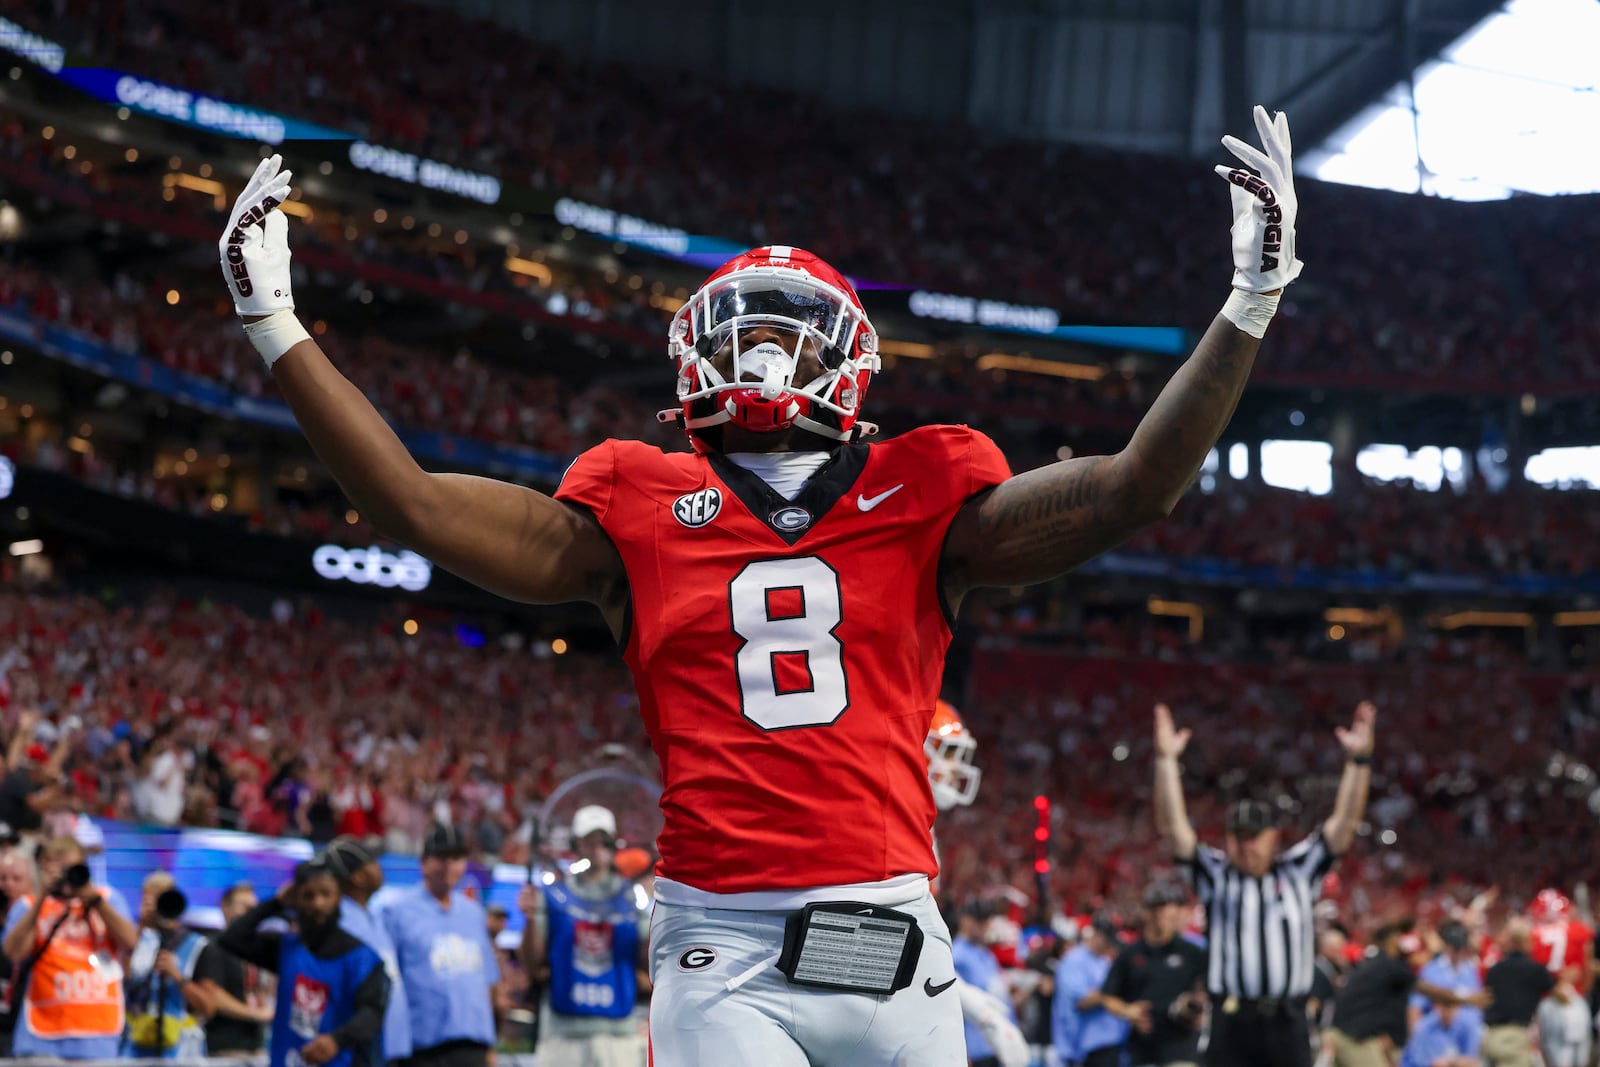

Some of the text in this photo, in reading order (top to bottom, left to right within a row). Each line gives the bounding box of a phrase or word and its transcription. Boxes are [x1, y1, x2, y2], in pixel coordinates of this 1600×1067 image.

[0, 16, 66, 74] RAND
[195, 96, 285, 145] BRAND
[418, 159, 501, 204] BRAND
[616, 214, 689, 257] BRAND
[1228, 170, 1283, 273] GEORGIA
[227, 195, 281, 297] GEORGIA
[976, 299, 1060, 334] BRAND
[756, 348, 783, 356] SHOCK
[677, 488, 719, 525] SEC
[728, 555, 850, 732] 8
